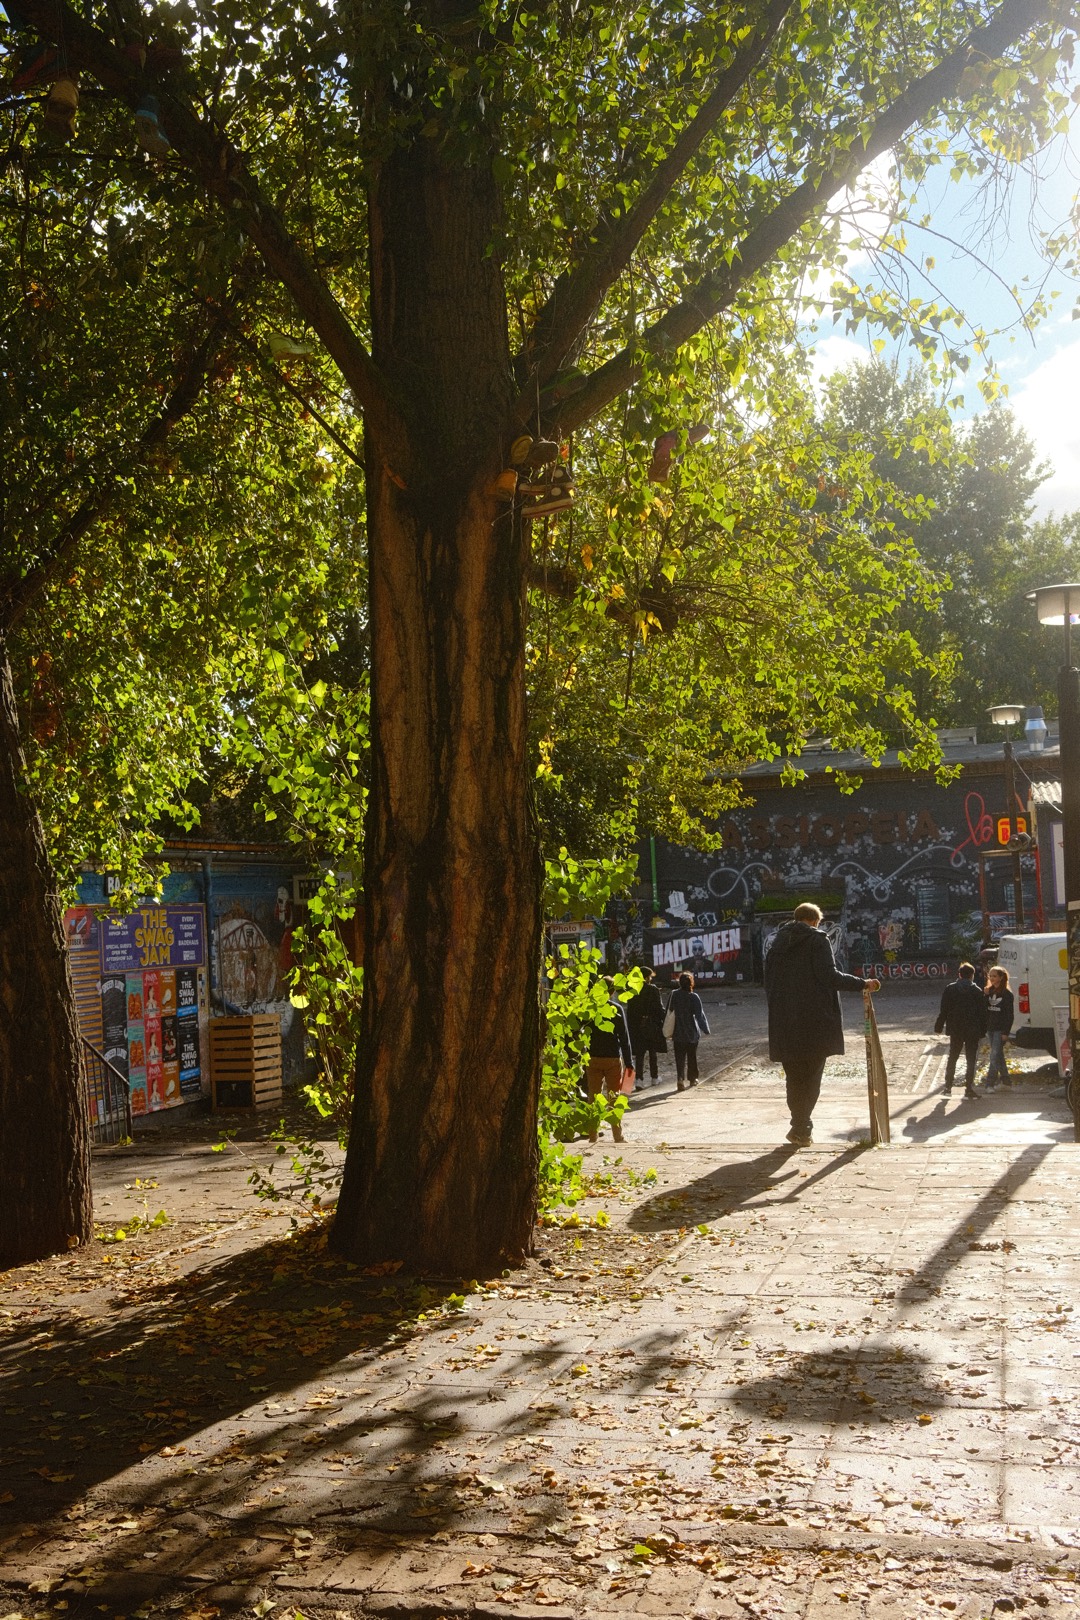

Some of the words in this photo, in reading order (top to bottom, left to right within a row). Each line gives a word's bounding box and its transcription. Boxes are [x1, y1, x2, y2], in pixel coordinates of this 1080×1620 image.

[705, 810, 941, 849] ASSIOPEIA
[140, 909, 168, 928] THE
[553, 925, 577, 933] Photo
[134, 927, 175, 948] SWAG
[652, 927, 741, 967] HALLOWEEN
[140, 946, 171, 966] JAM
[862, 962, 948, 979] FRESCO!
[181, 980, 192, 989] THE
[178, 989, 195, 997] SWAG
[180, 997, 193, 1006] JAM
[183, 1043, 195, 1052] THE
[181, 1051, 197, 1060] SWAG
[183, 1059, 196, 1069] JAM
